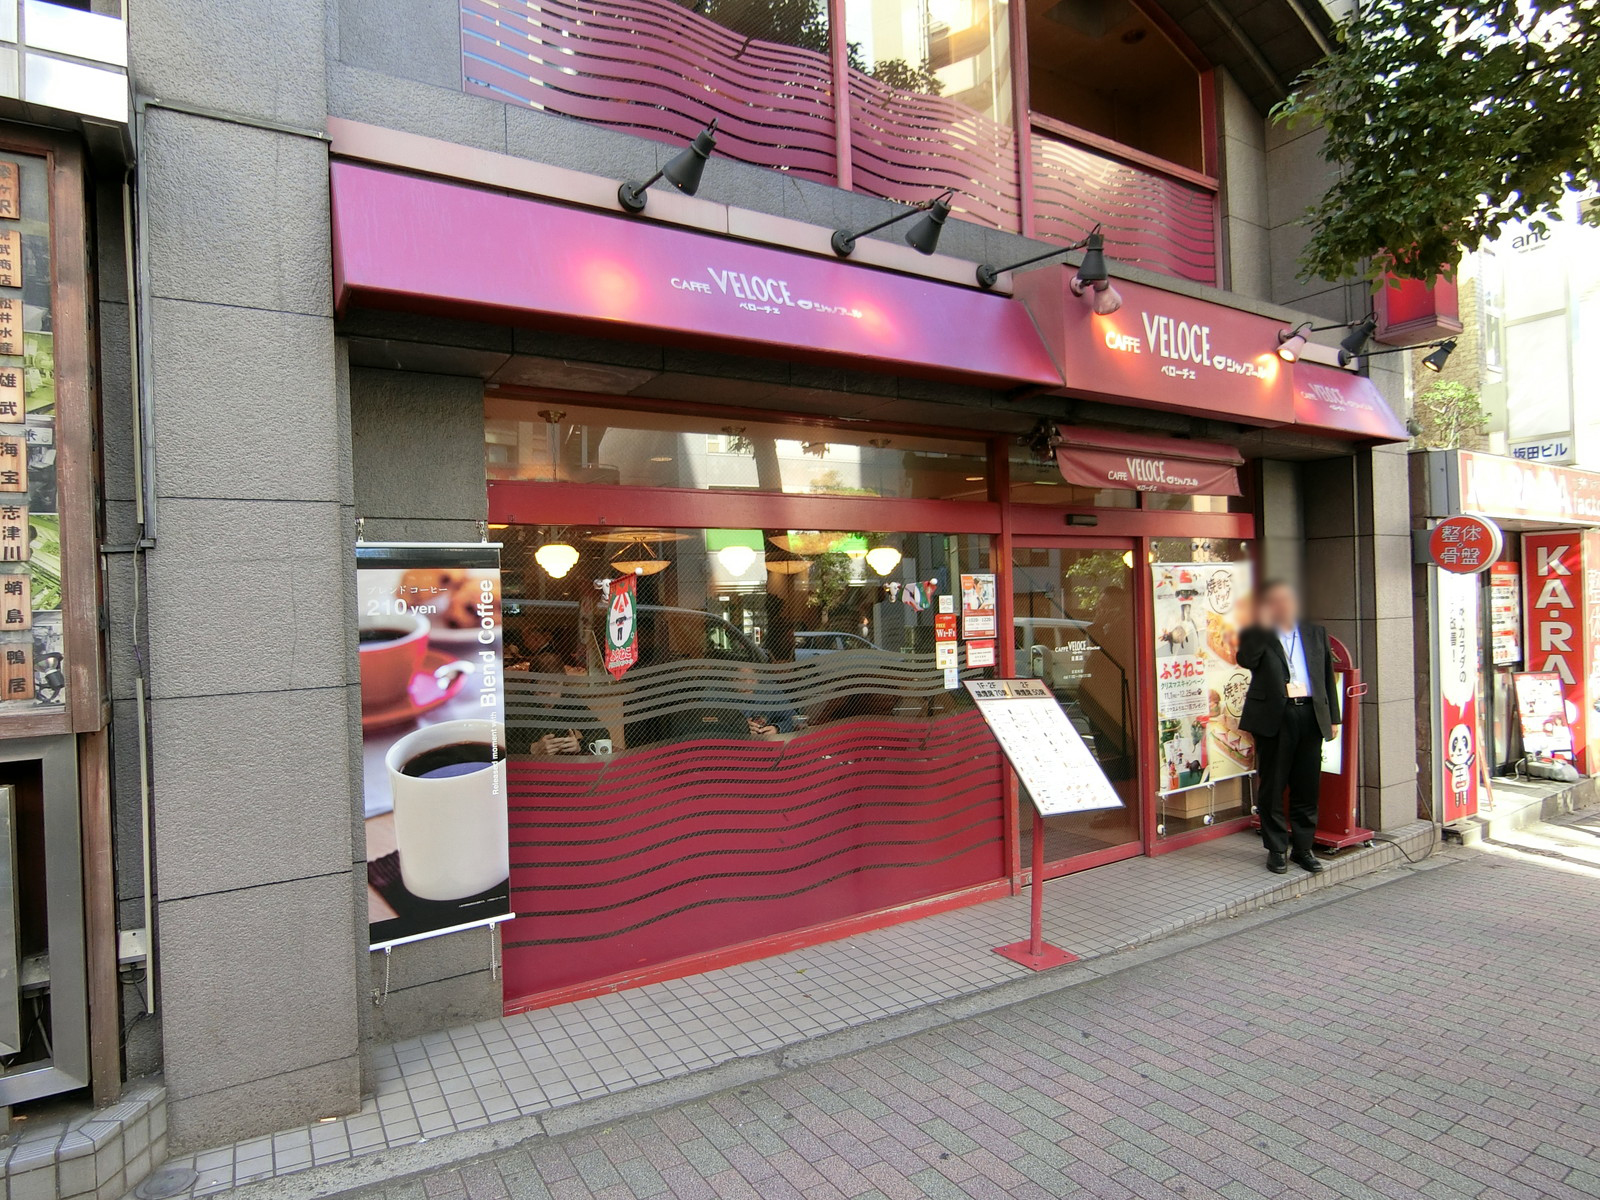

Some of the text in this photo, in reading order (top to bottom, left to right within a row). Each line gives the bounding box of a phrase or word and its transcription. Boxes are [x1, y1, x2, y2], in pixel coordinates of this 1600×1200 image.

[671, 266, 795, 307] CAFFE VELOCE
[739, 302, 781, 314] ベローチェ
[1105, 311, 1211, 367] CAFFE VELOCE
[1161, 365, 1196, 380] ベローチェ
[1512, 443, 1568, 460] 坂田ビル
[0, 442, 20, 485] 海宝
[1108, 457, 1166, 483] CAFFE VELOCE
[2, 506, 21, 561] 志津川
[1441, 525, 1482, 542] 整体
[1440, 547, 1481, 565] 骨盤
[367, 585, 448, 595] ブレンド コーヒー
[4, 580, 25, 624] 蛸島
[367, 598, 437, 616] 210 yen
[477, 579, 497, 708] Blend Coffee
[936, 629, 956, 638] Wi-Fi
[7, 650, 26, 693] 鴨居
[1160, 661, 1204, 680] ふちねこ
[490, 728, 499, 760] moment
